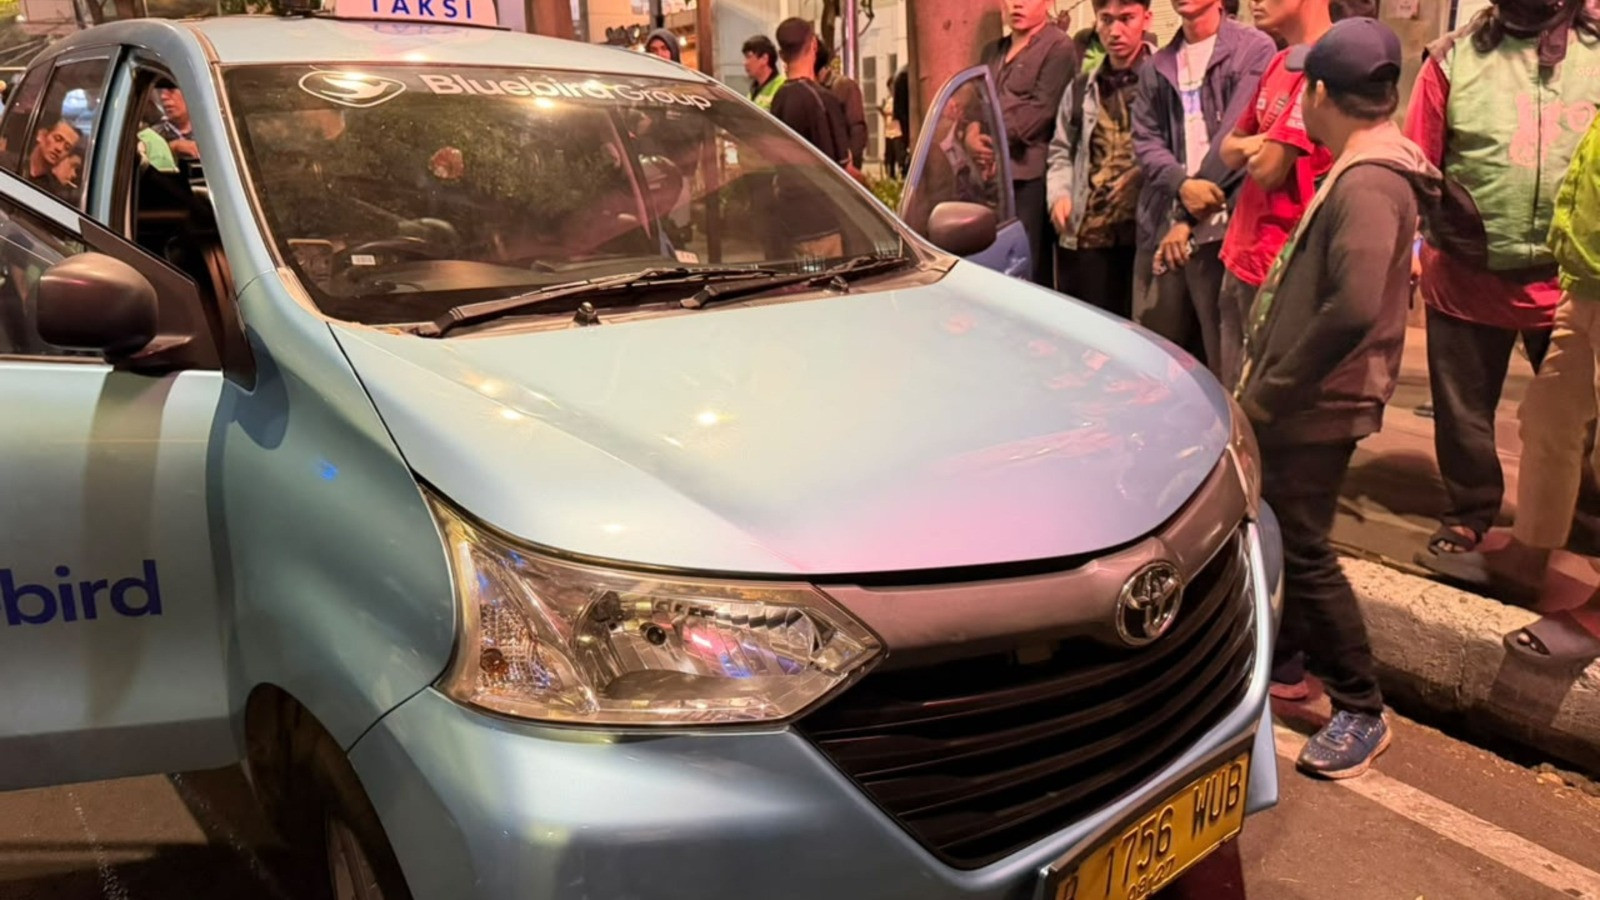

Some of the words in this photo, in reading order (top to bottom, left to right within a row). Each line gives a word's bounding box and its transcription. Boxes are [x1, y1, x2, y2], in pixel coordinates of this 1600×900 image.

[419, 73, 615, 100] Bluebird
[613, 84, 712, 110] Group
[0, 559, 162, 626] bird
[1105, 804, 1175, 896] 1756
[1191, 762, 1242, 839] WUB
